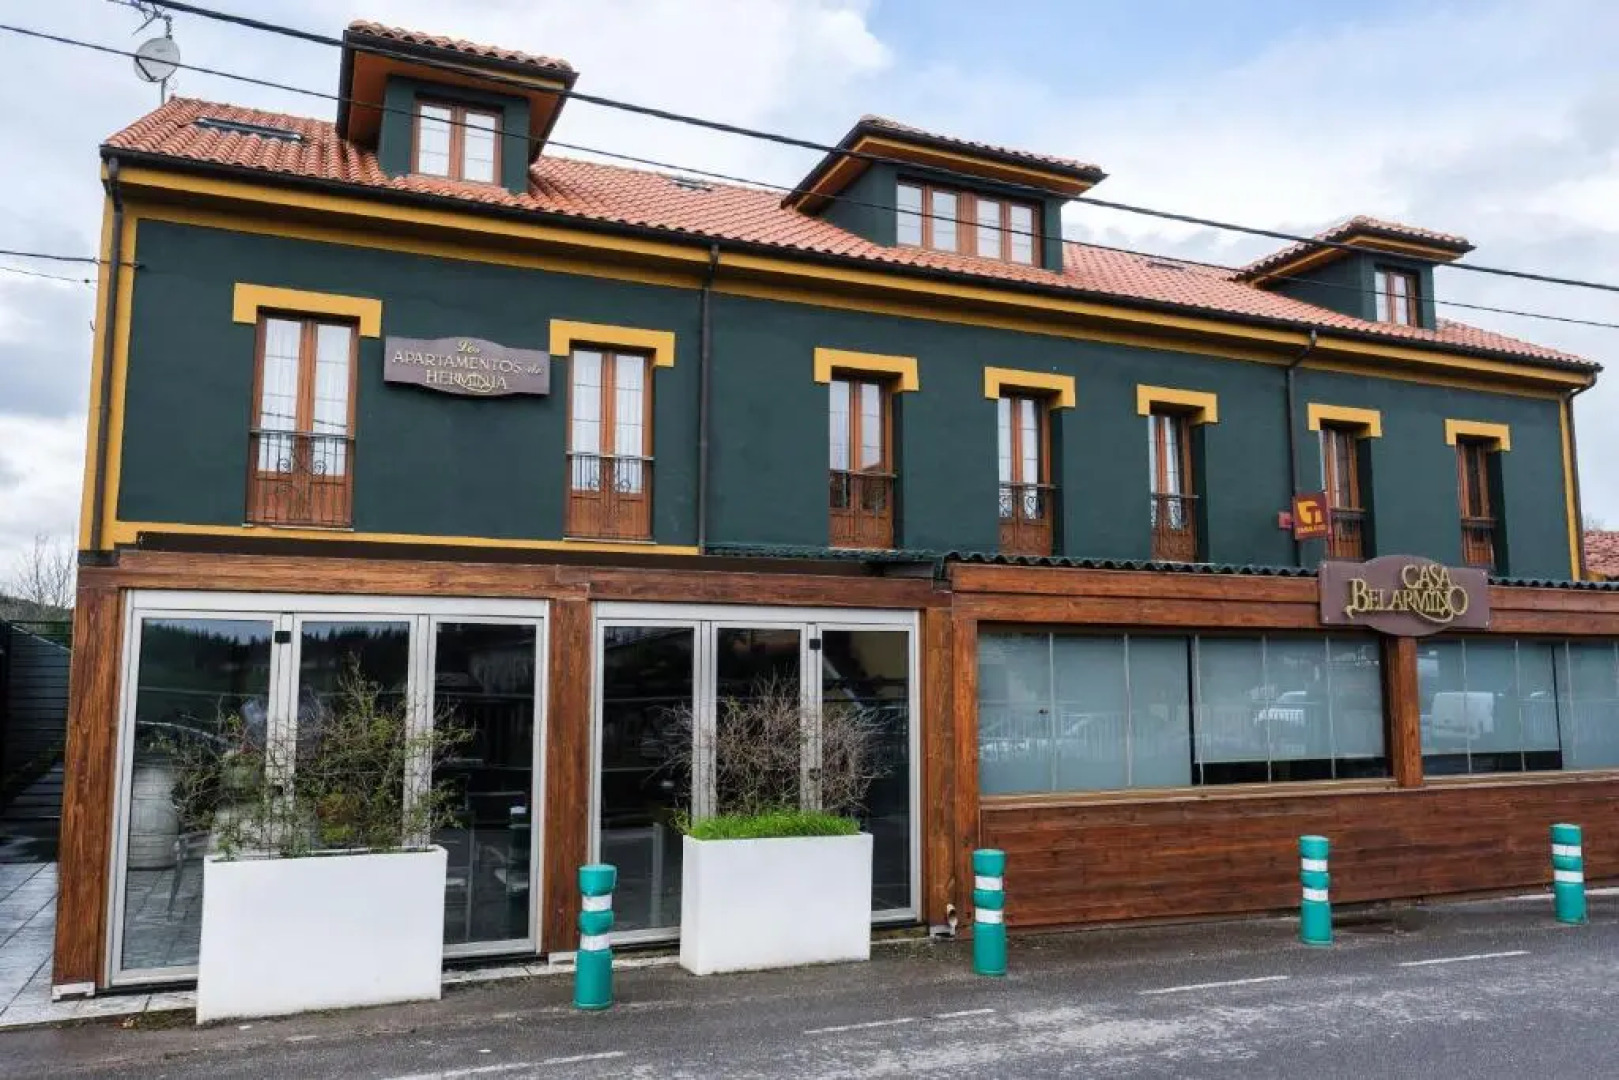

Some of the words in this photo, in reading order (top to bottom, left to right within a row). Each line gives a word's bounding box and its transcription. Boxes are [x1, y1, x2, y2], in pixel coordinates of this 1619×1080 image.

[392, 350, 522, 373] APARTAMENTOS
[1402, 564, 1451, 589] CASA
[1344, 578, 1469, 623] BELARMINO
